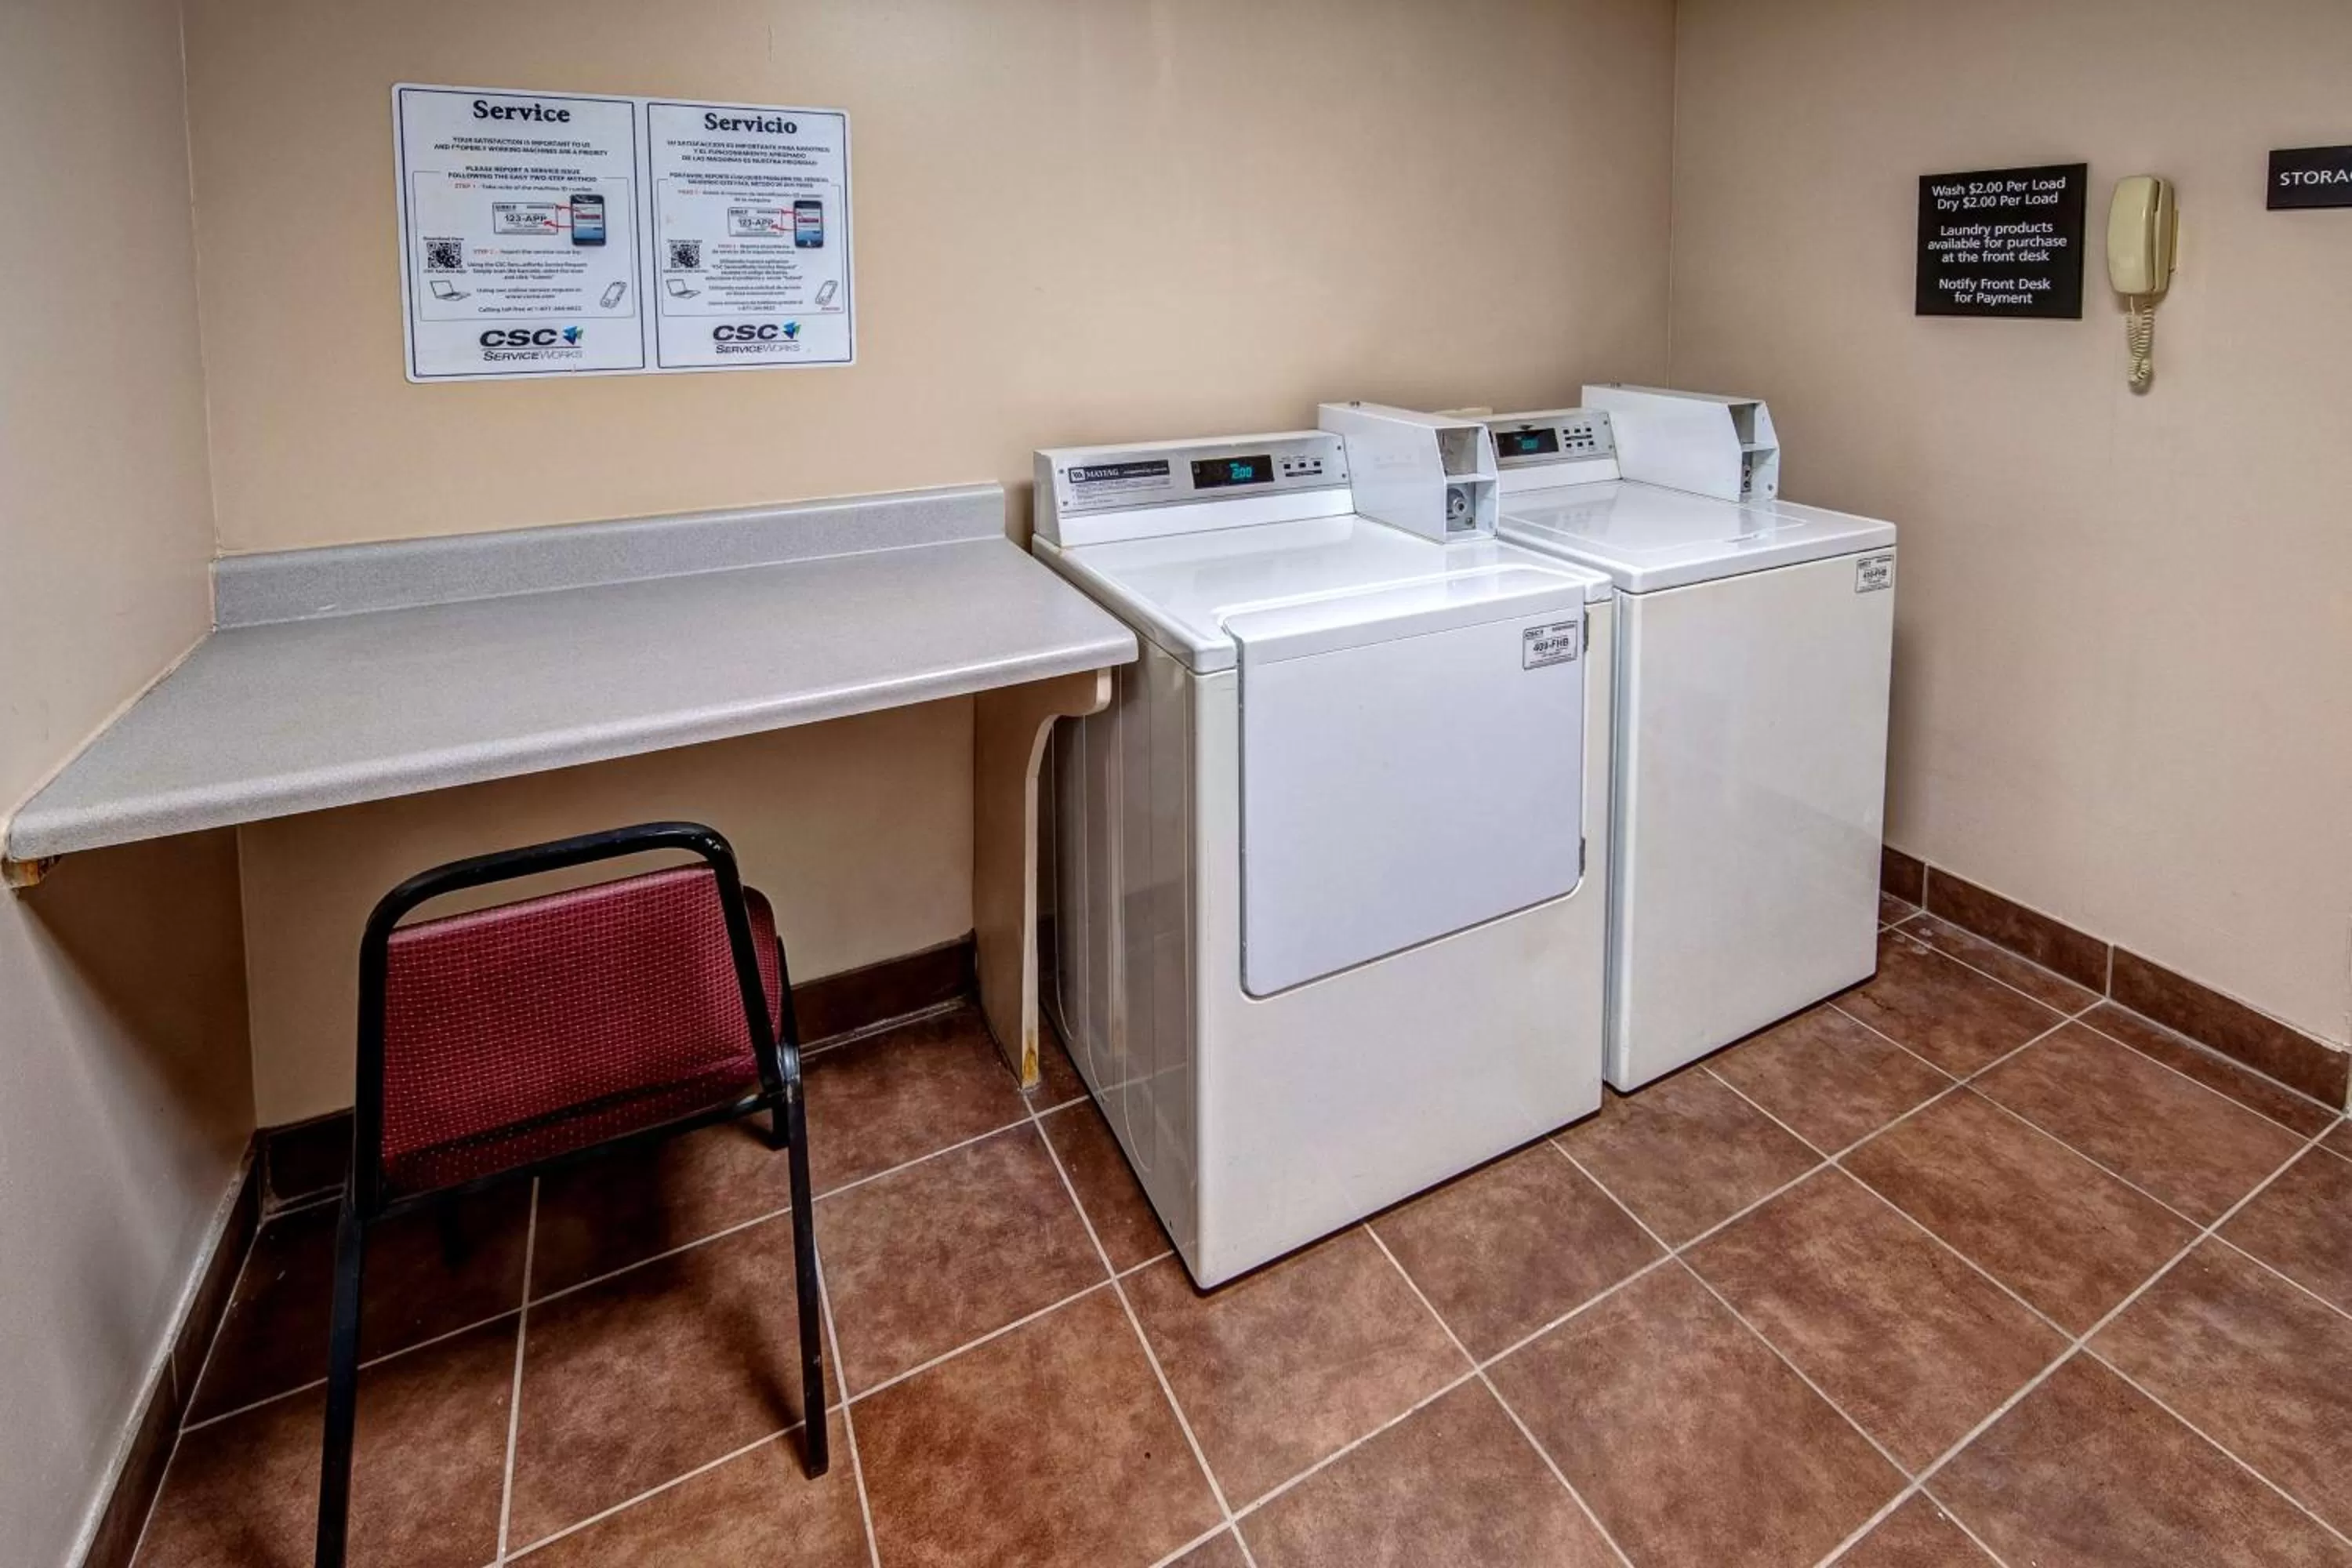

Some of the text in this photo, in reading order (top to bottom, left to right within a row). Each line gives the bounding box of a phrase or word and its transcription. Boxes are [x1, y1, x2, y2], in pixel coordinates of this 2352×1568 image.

[473, 100, 570, 123] Service
[704, 112, 797, 134] Servicio
[2280, 169, 2352, 186] STORA
[1932, 176, 2066, 197] Wash $2.00 Per Load
[1937, 191, 2058, 212] Dry $2.00 Per Load
[504, 212, 547, 222] 123-APP
[738, 219, 774, 227] 123-APP
[1940, 220, 2053, 238] Laundry products
[1928, 234, 2067, 250] available for purchase
[1942, 249, 2050, 263] at the front desk
[1939, 277, 2051, 292] Notify Front Desk
[1954, 291, 2033, 307] for Payment
[480, 328, 557, 347] CSC
[713, 324, 779, 342] CSC
